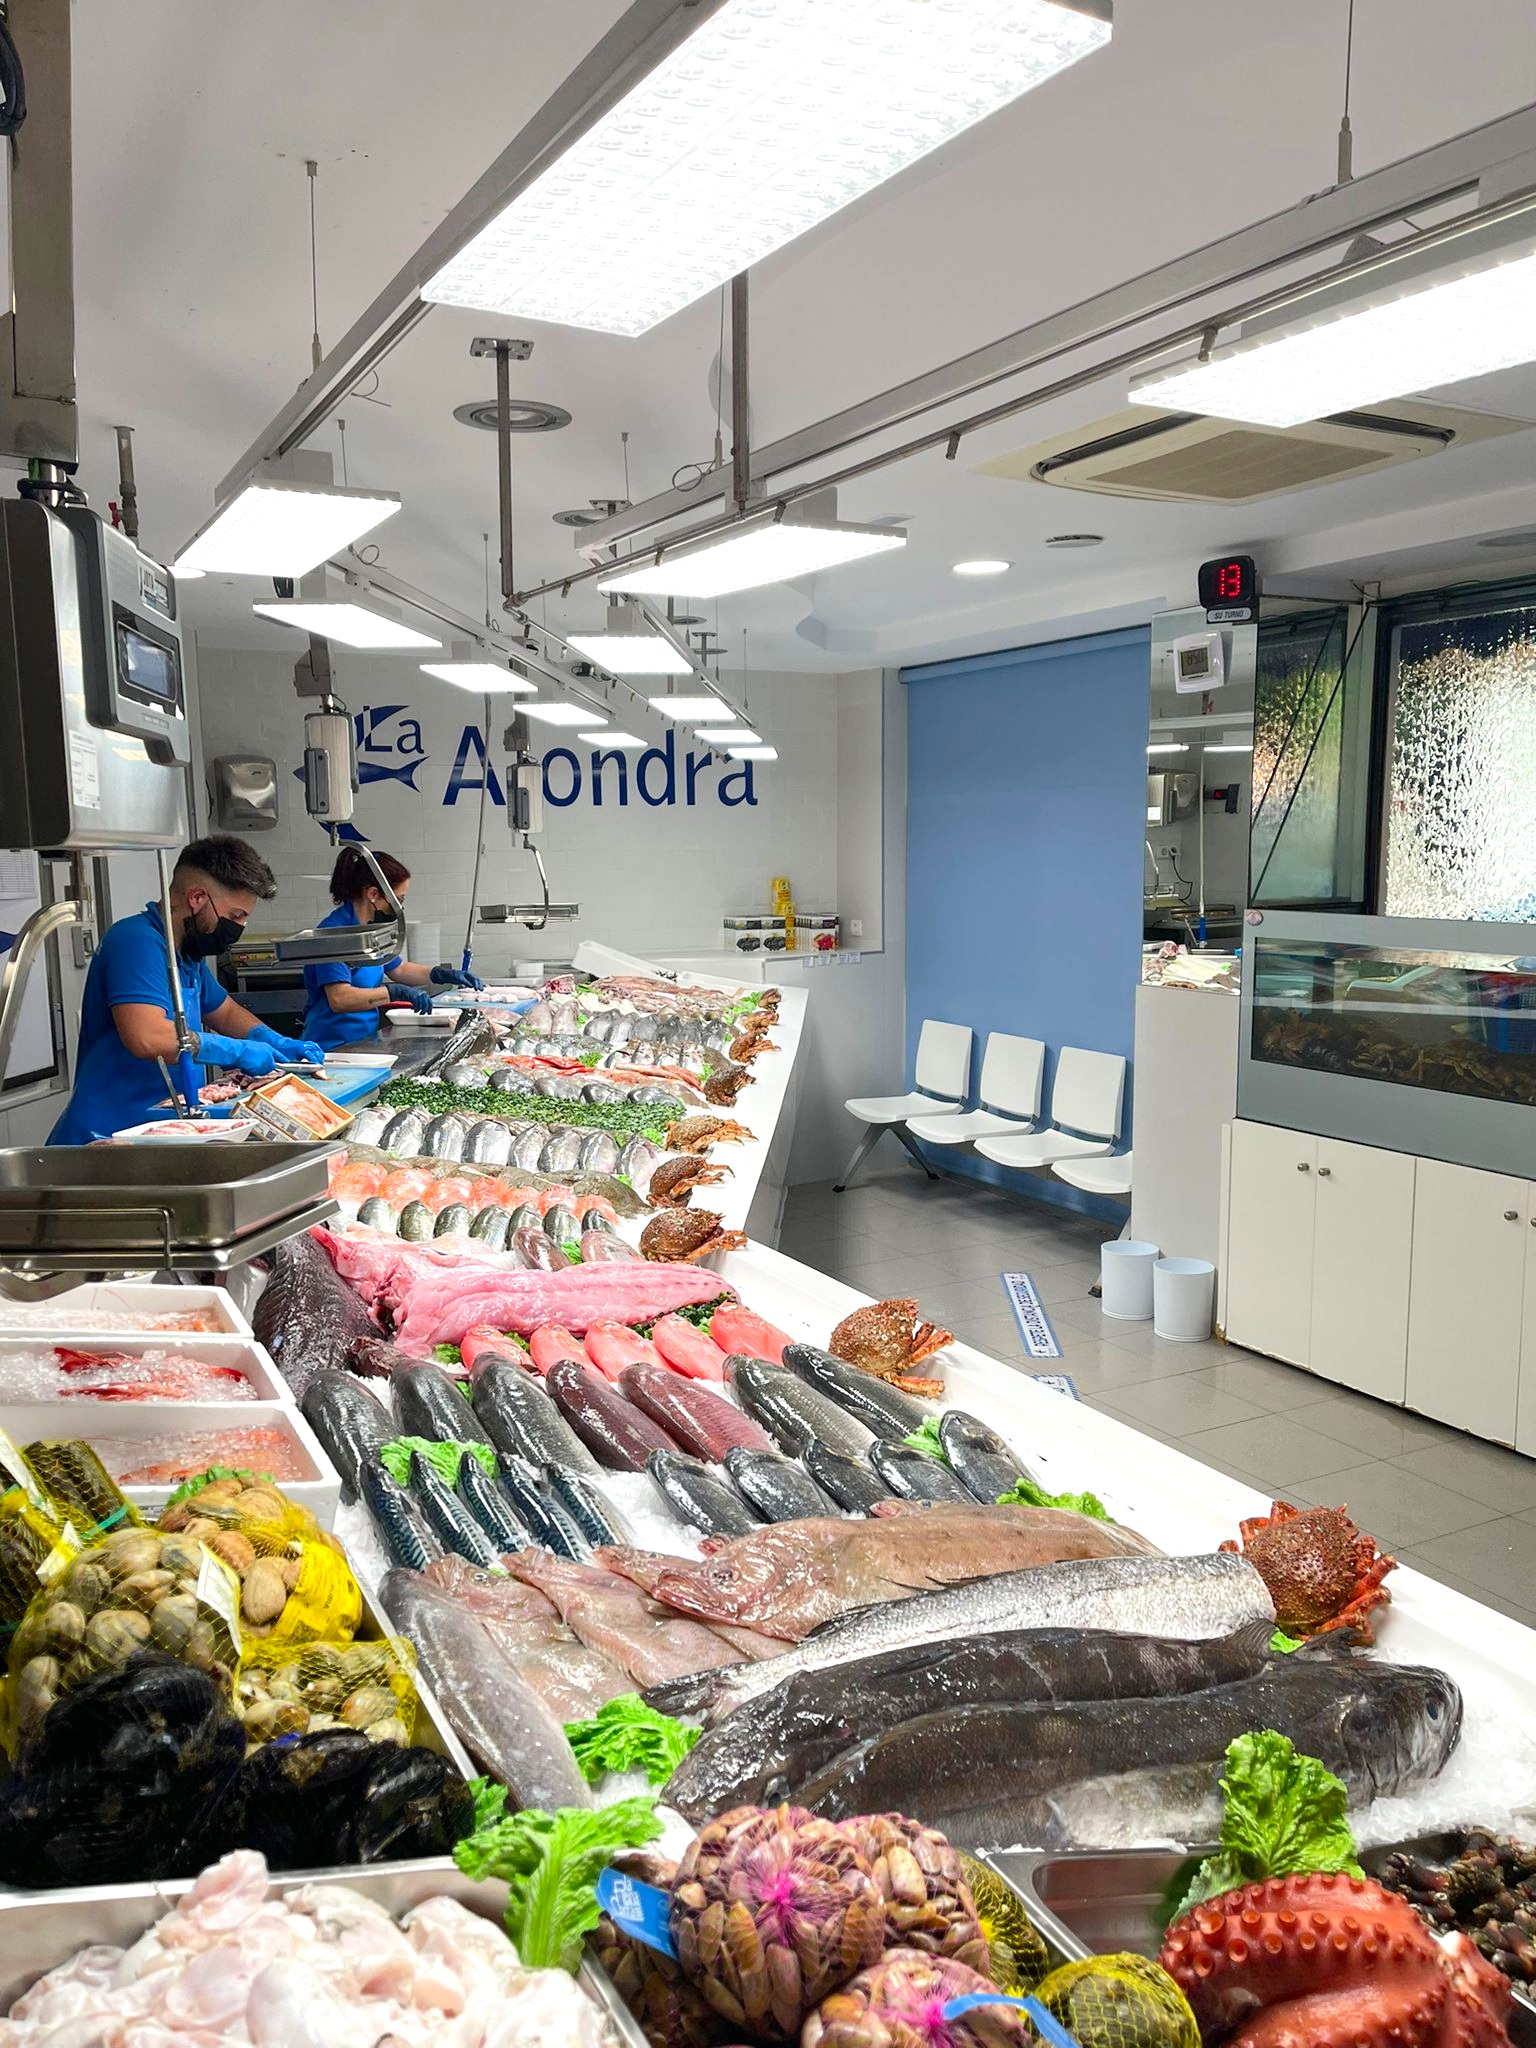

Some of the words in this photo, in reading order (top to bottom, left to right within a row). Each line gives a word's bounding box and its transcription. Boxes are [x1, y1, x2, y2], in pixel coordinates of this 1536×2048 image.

[1219, 563, 1241, 597] 13
[1214, 611, 1224, 620] SU
[1224, 609, 1245, 619] TURNO
[362, 705, 425, 755] La
[441, 725, 759, 808] Aondra
